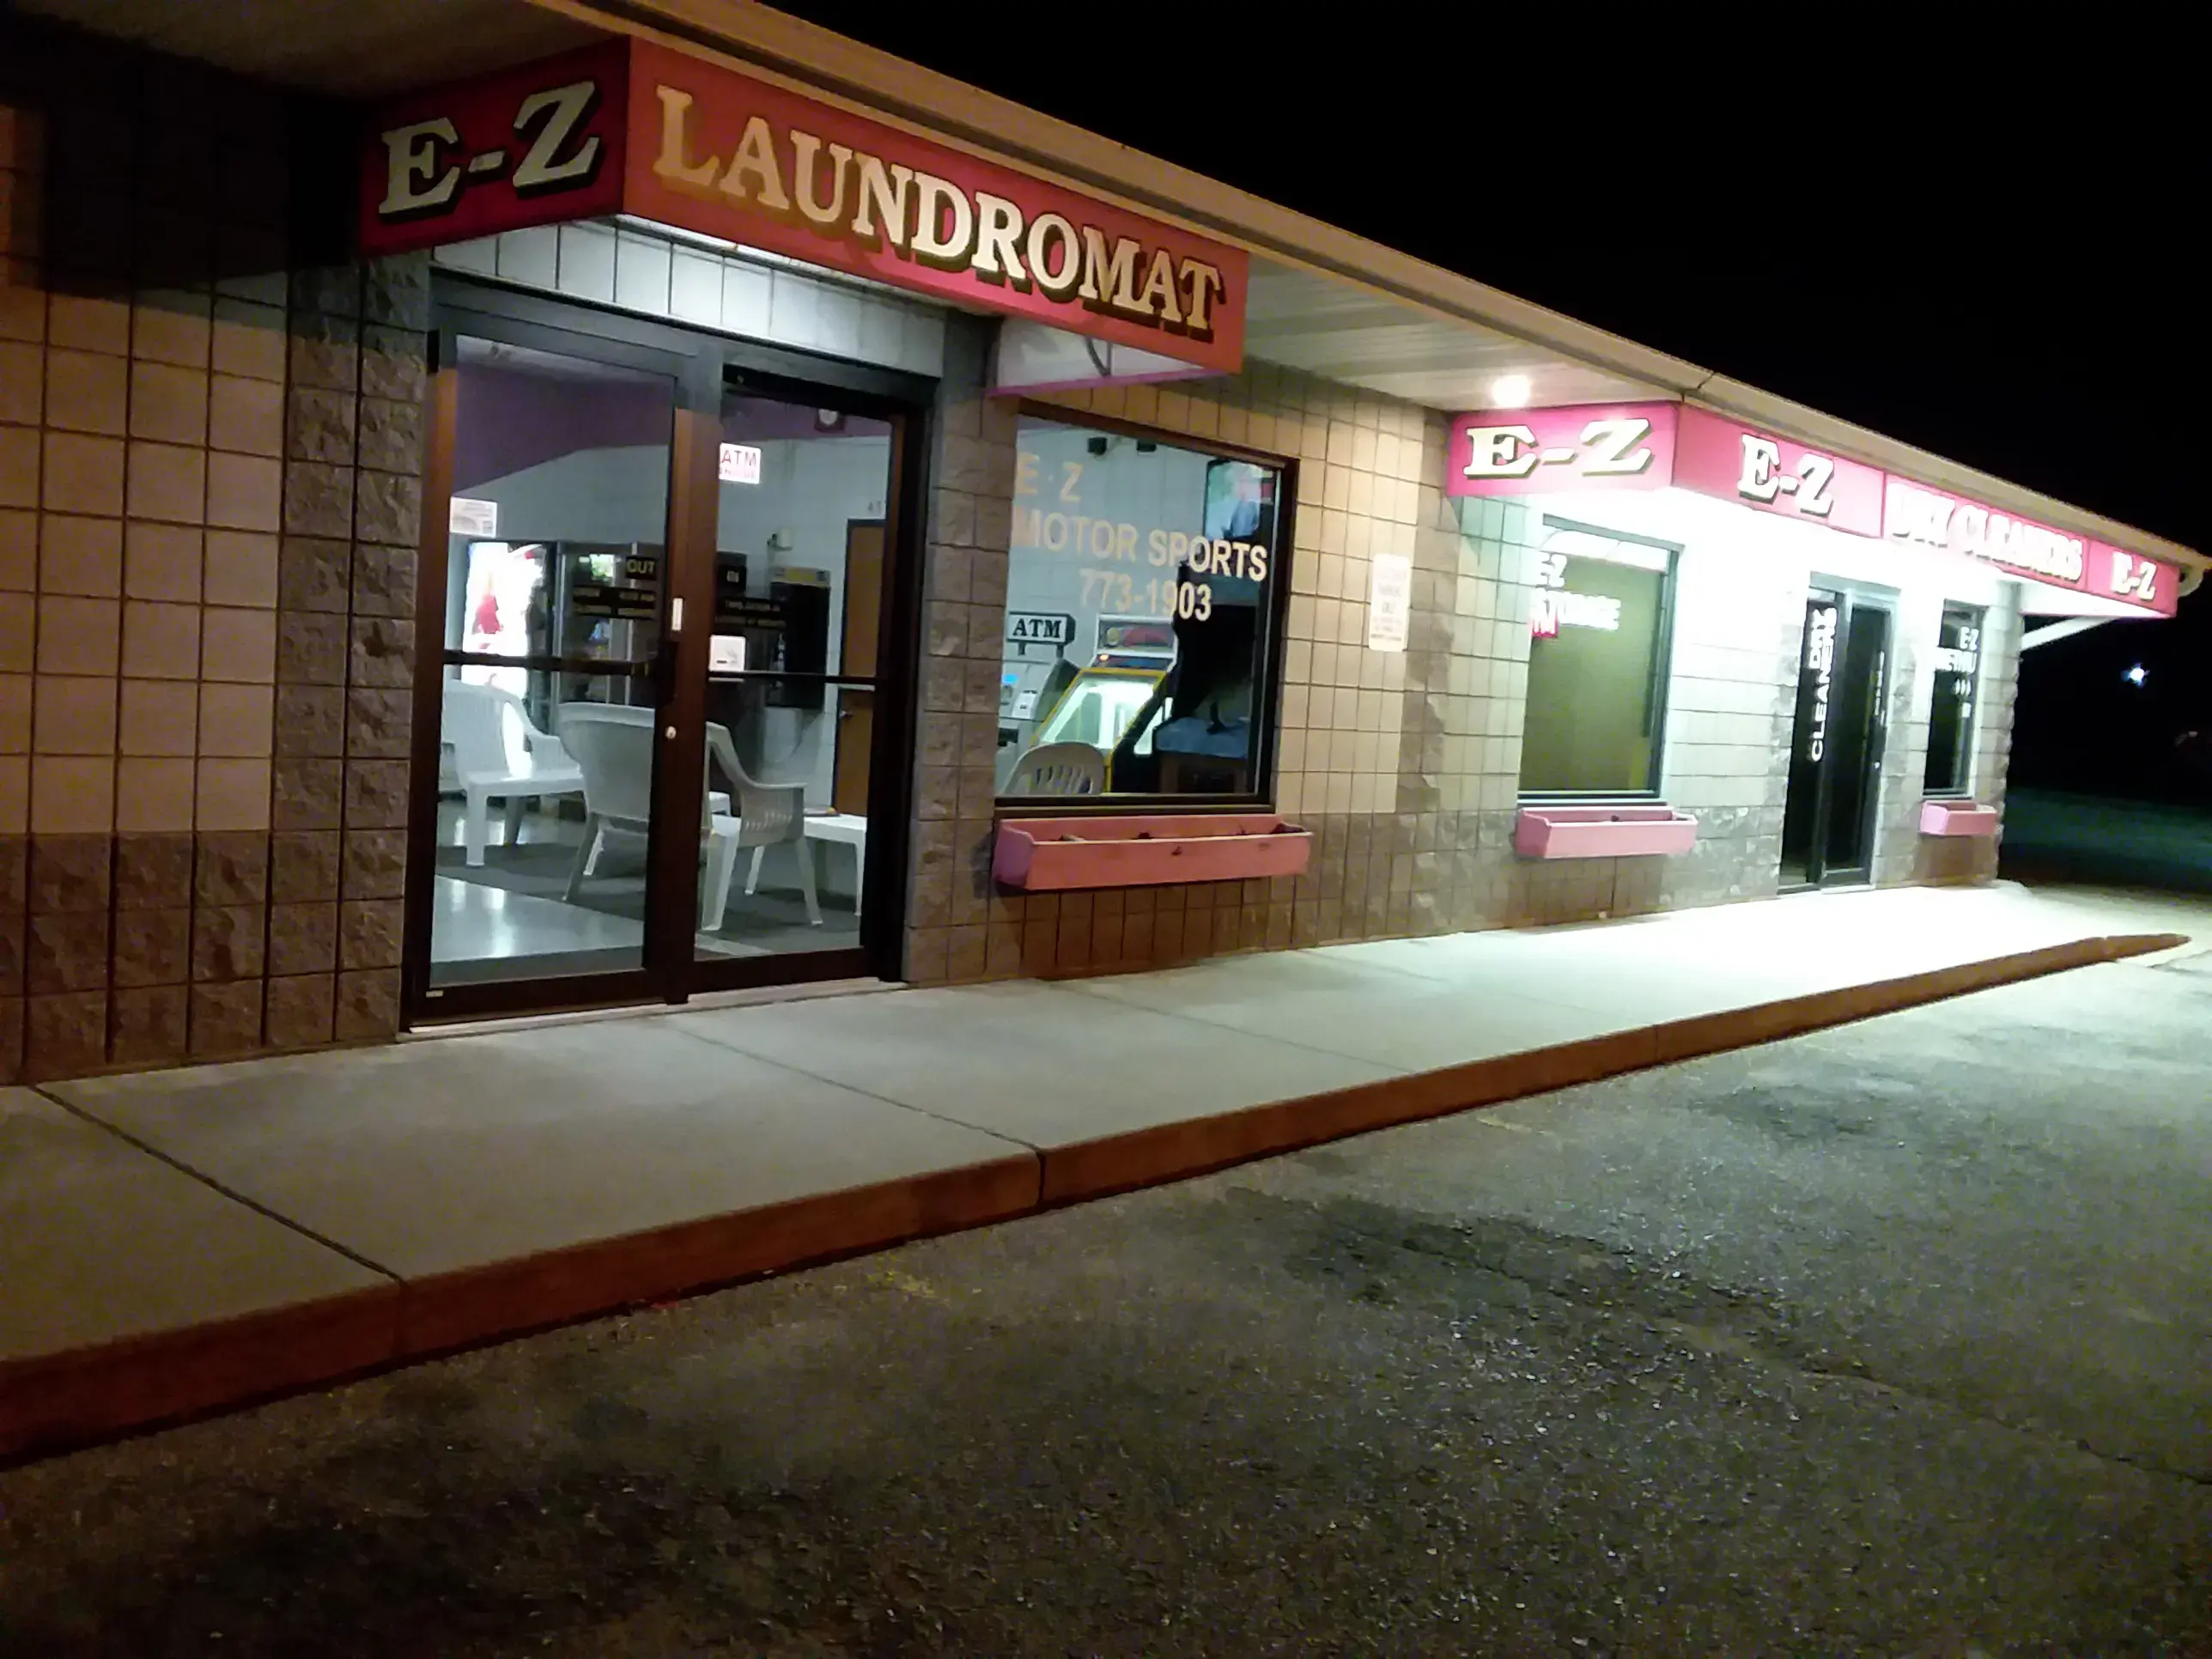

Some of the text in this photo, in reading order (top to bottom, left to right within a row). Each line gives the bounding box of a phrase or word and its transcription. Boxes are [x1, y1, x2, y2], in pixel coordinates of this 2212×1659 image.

[376, 79, 605, 218] E-Z
[651, 83, 1224, 341] LAUNDROMAT
[720, 449, 757, 467] ATM
[1462, 417, 1654, 479] E-Z
[1737, 433, 1835, 518] E-Z
[1011, 505, 1268, 582] MOTOR SPORTS
[1012, 617, 1062, 638] ATM
[1079, 568, 1212, 622] 773-1903
